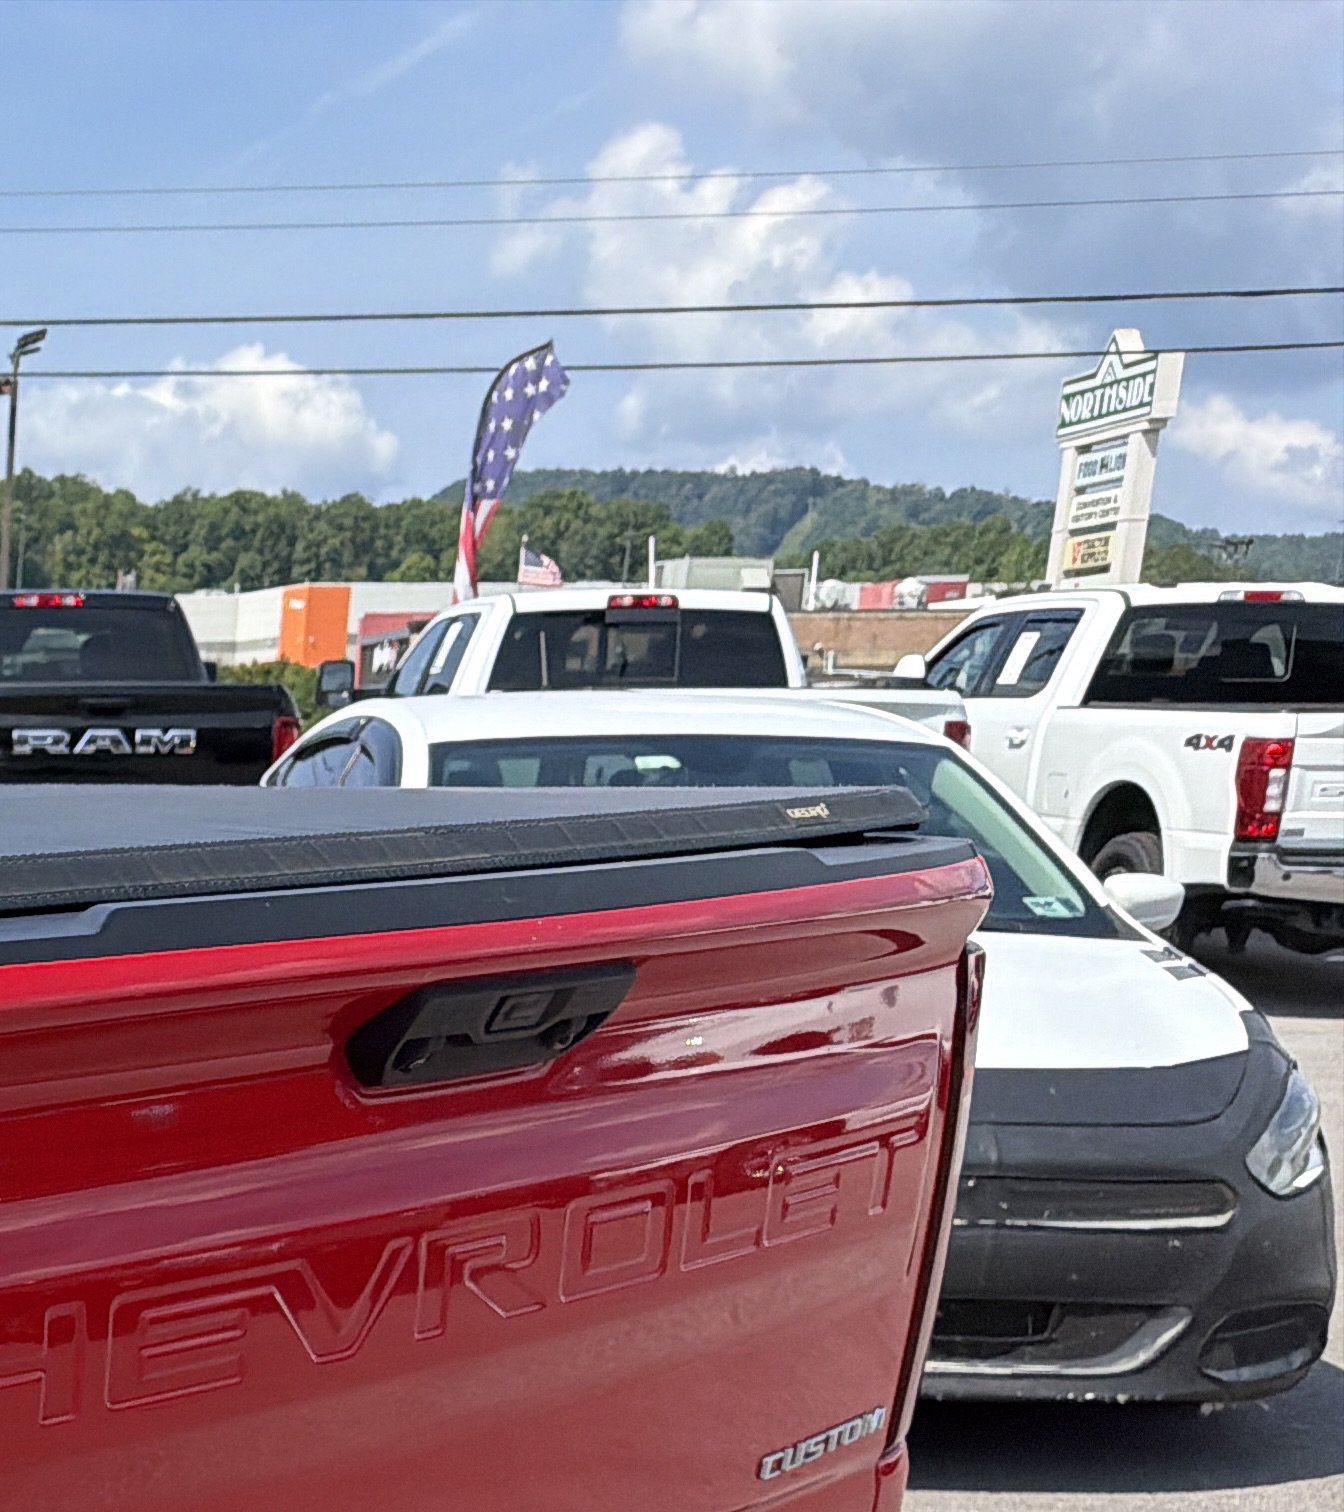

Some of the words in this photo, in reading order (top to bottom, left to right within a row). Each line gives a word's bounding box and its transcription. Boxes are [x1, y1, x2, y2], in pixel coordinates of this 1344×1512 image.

[1060, 372, 1155, 425] NORTHSIDE
[12, 728, 197, 755] RAM
[758, 1406, 887, 1480] CUSTOM
